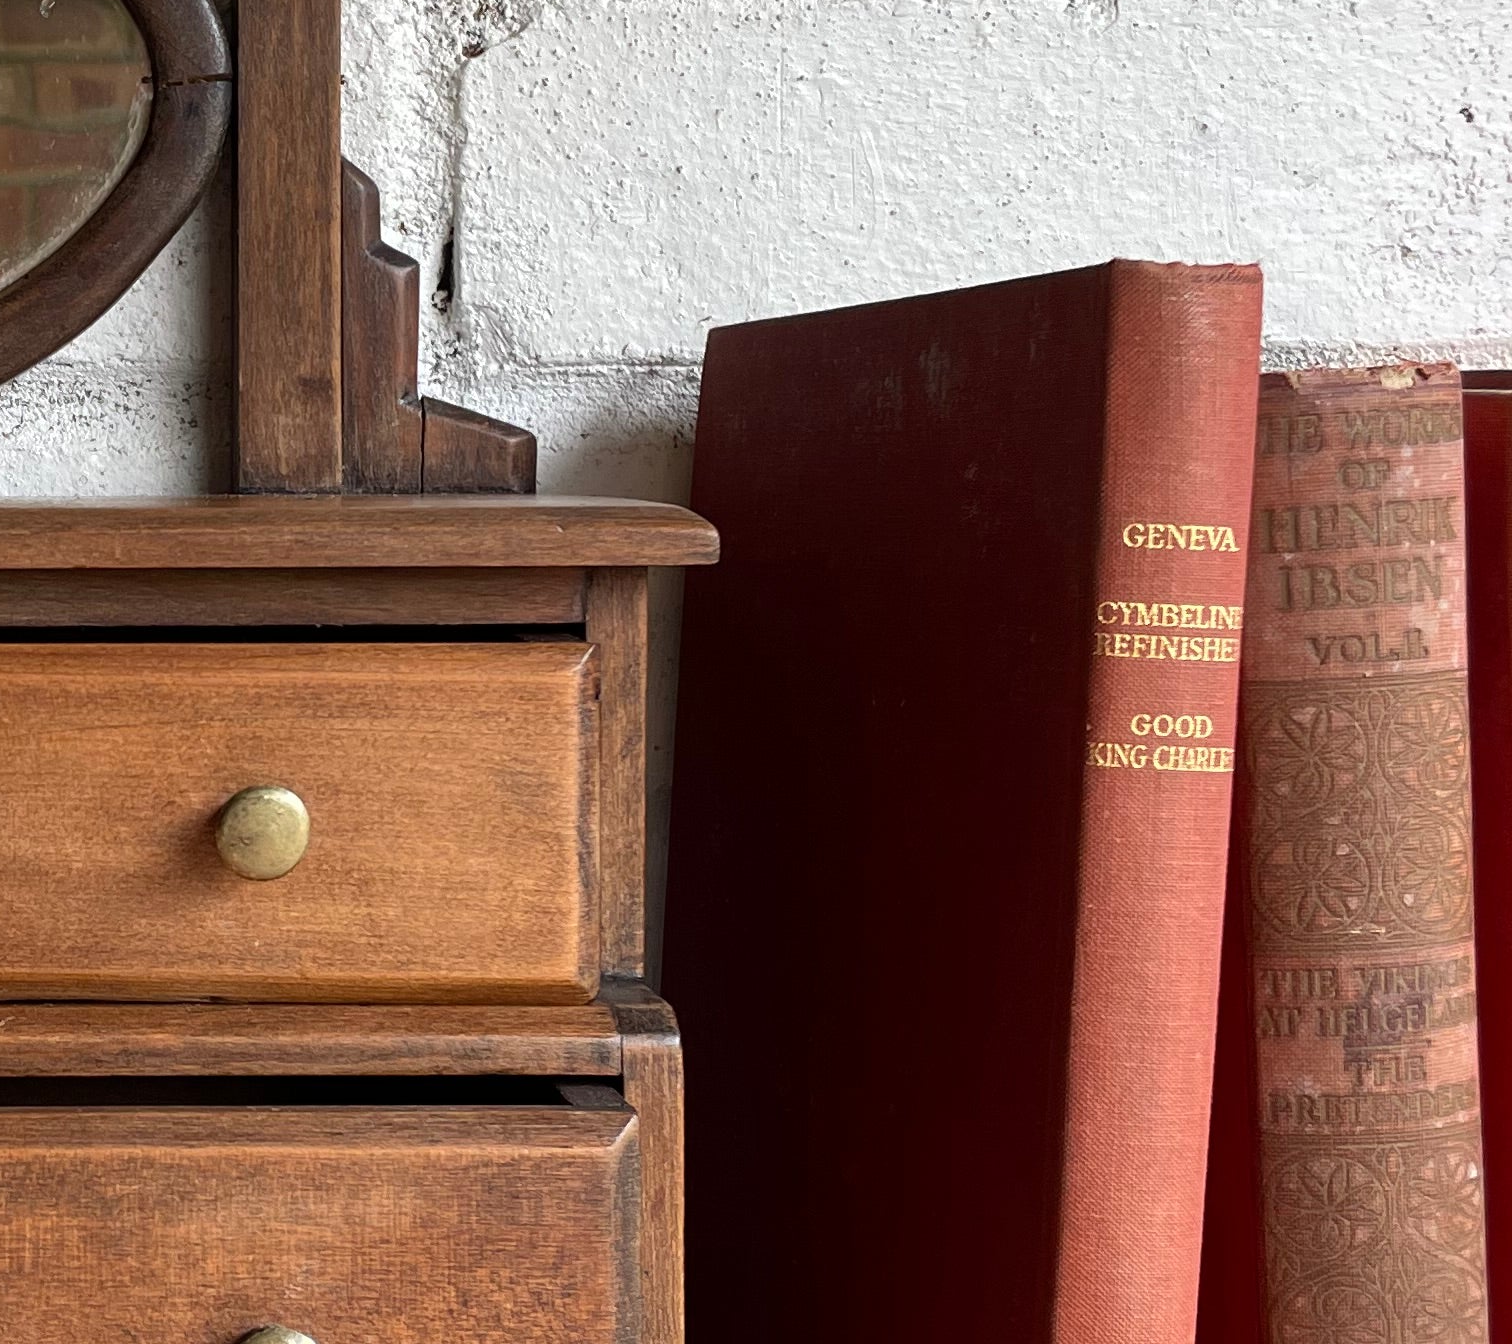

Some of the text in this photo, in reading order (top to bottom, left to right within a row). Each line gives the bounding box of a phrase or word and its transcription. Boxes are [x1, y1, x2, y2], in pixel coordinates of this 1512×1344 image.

[1258, 412, 1322, 455] HE
[1338, 459, 1389, 490] OF
[1123, 523, 1240, 552] GENEVA
[1260, 497, 1458, 554] HENRIK
[1278, 556, 1445, 612] IBSEN
[1097, 601, 1244, 630] CYMBELINE
[1093, 633, 1240, 663] REFINISHE
[1130, 714, 1214, 739] GOOD
[1086, 742, 1235, 772] KING CHARLE
[1258, 967, 1338, 1002] THE
[1349, 1055, 1427, 1087] THE
